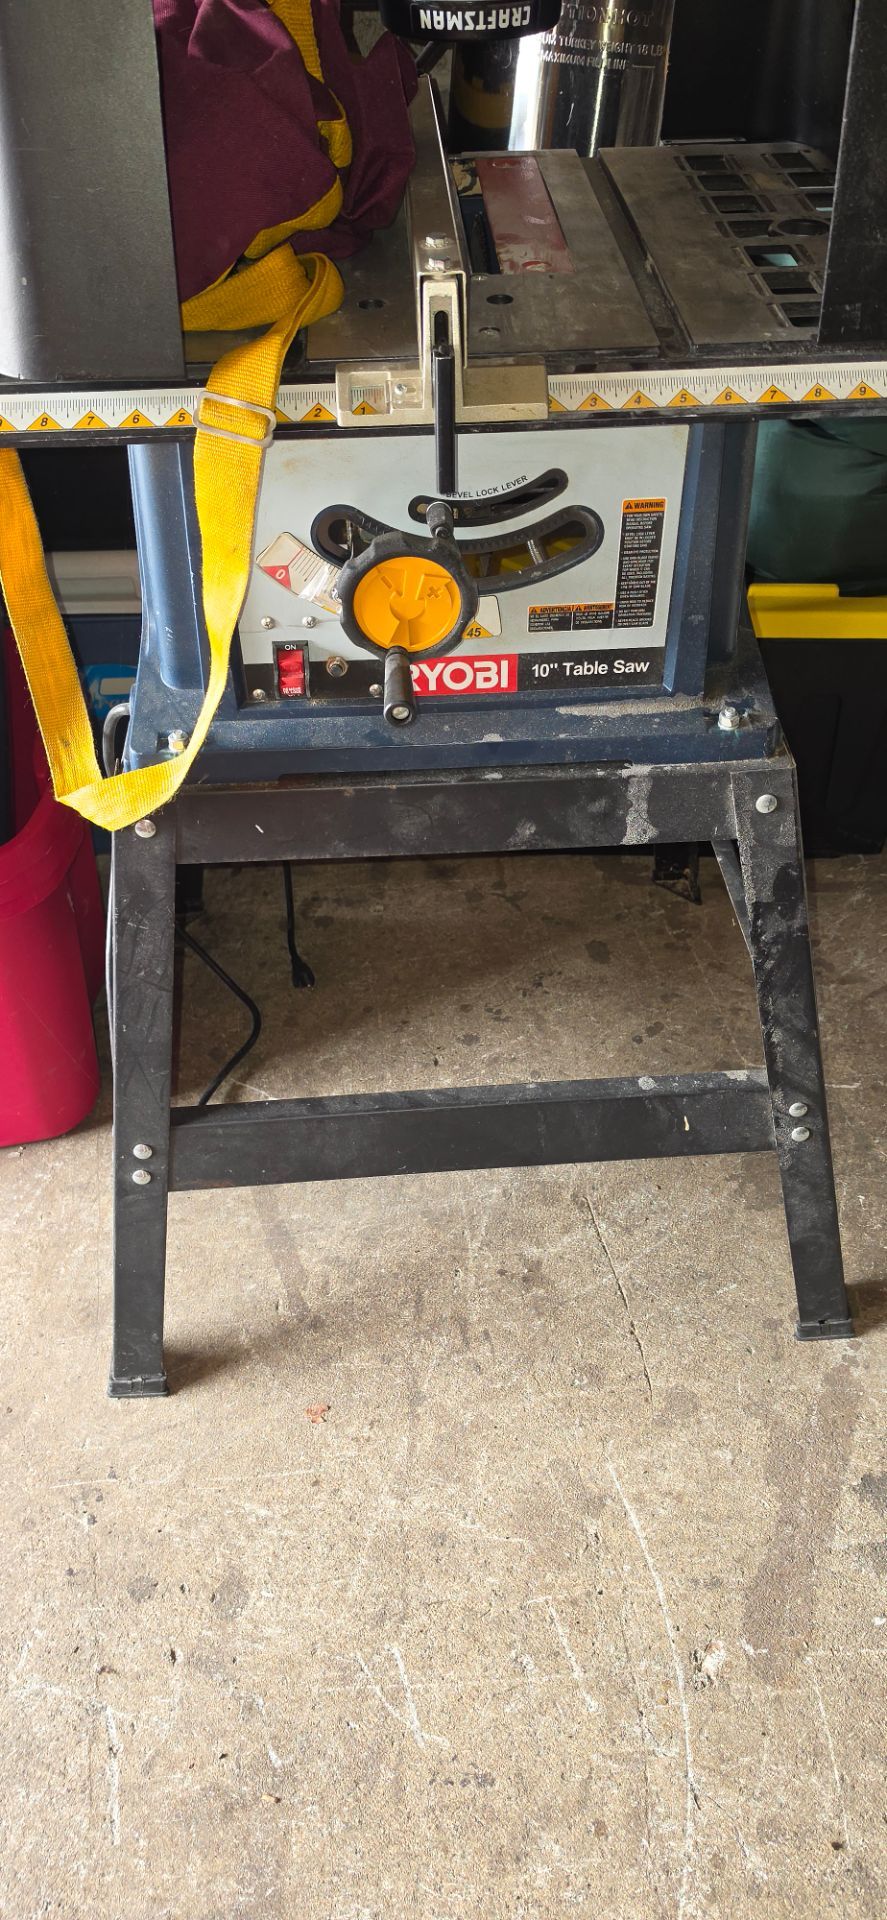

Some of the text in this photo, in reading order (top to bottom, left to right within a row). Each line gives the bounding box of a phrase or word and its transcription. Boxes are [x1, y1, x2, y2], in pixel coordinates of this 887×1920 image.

[419, 6, 531, 31] CRAFTSMAN
[559, 35, 597, 50] TURKEY
[541, 50, 585, 66] MAXIMUM
[589, 386, 867, 407] 3 4 5 6 7 8 9
[40, 407, 366, 427] 8 7 6 5 2 1
[476, 486, 499, 497] LOCK
[501, 475, 528, 491] LEVER
[275, 568, 286, 580] 0
[466, 627, 481, 638] 45
[409, 659, 650, 692] RYOBI 10" Table Saw
